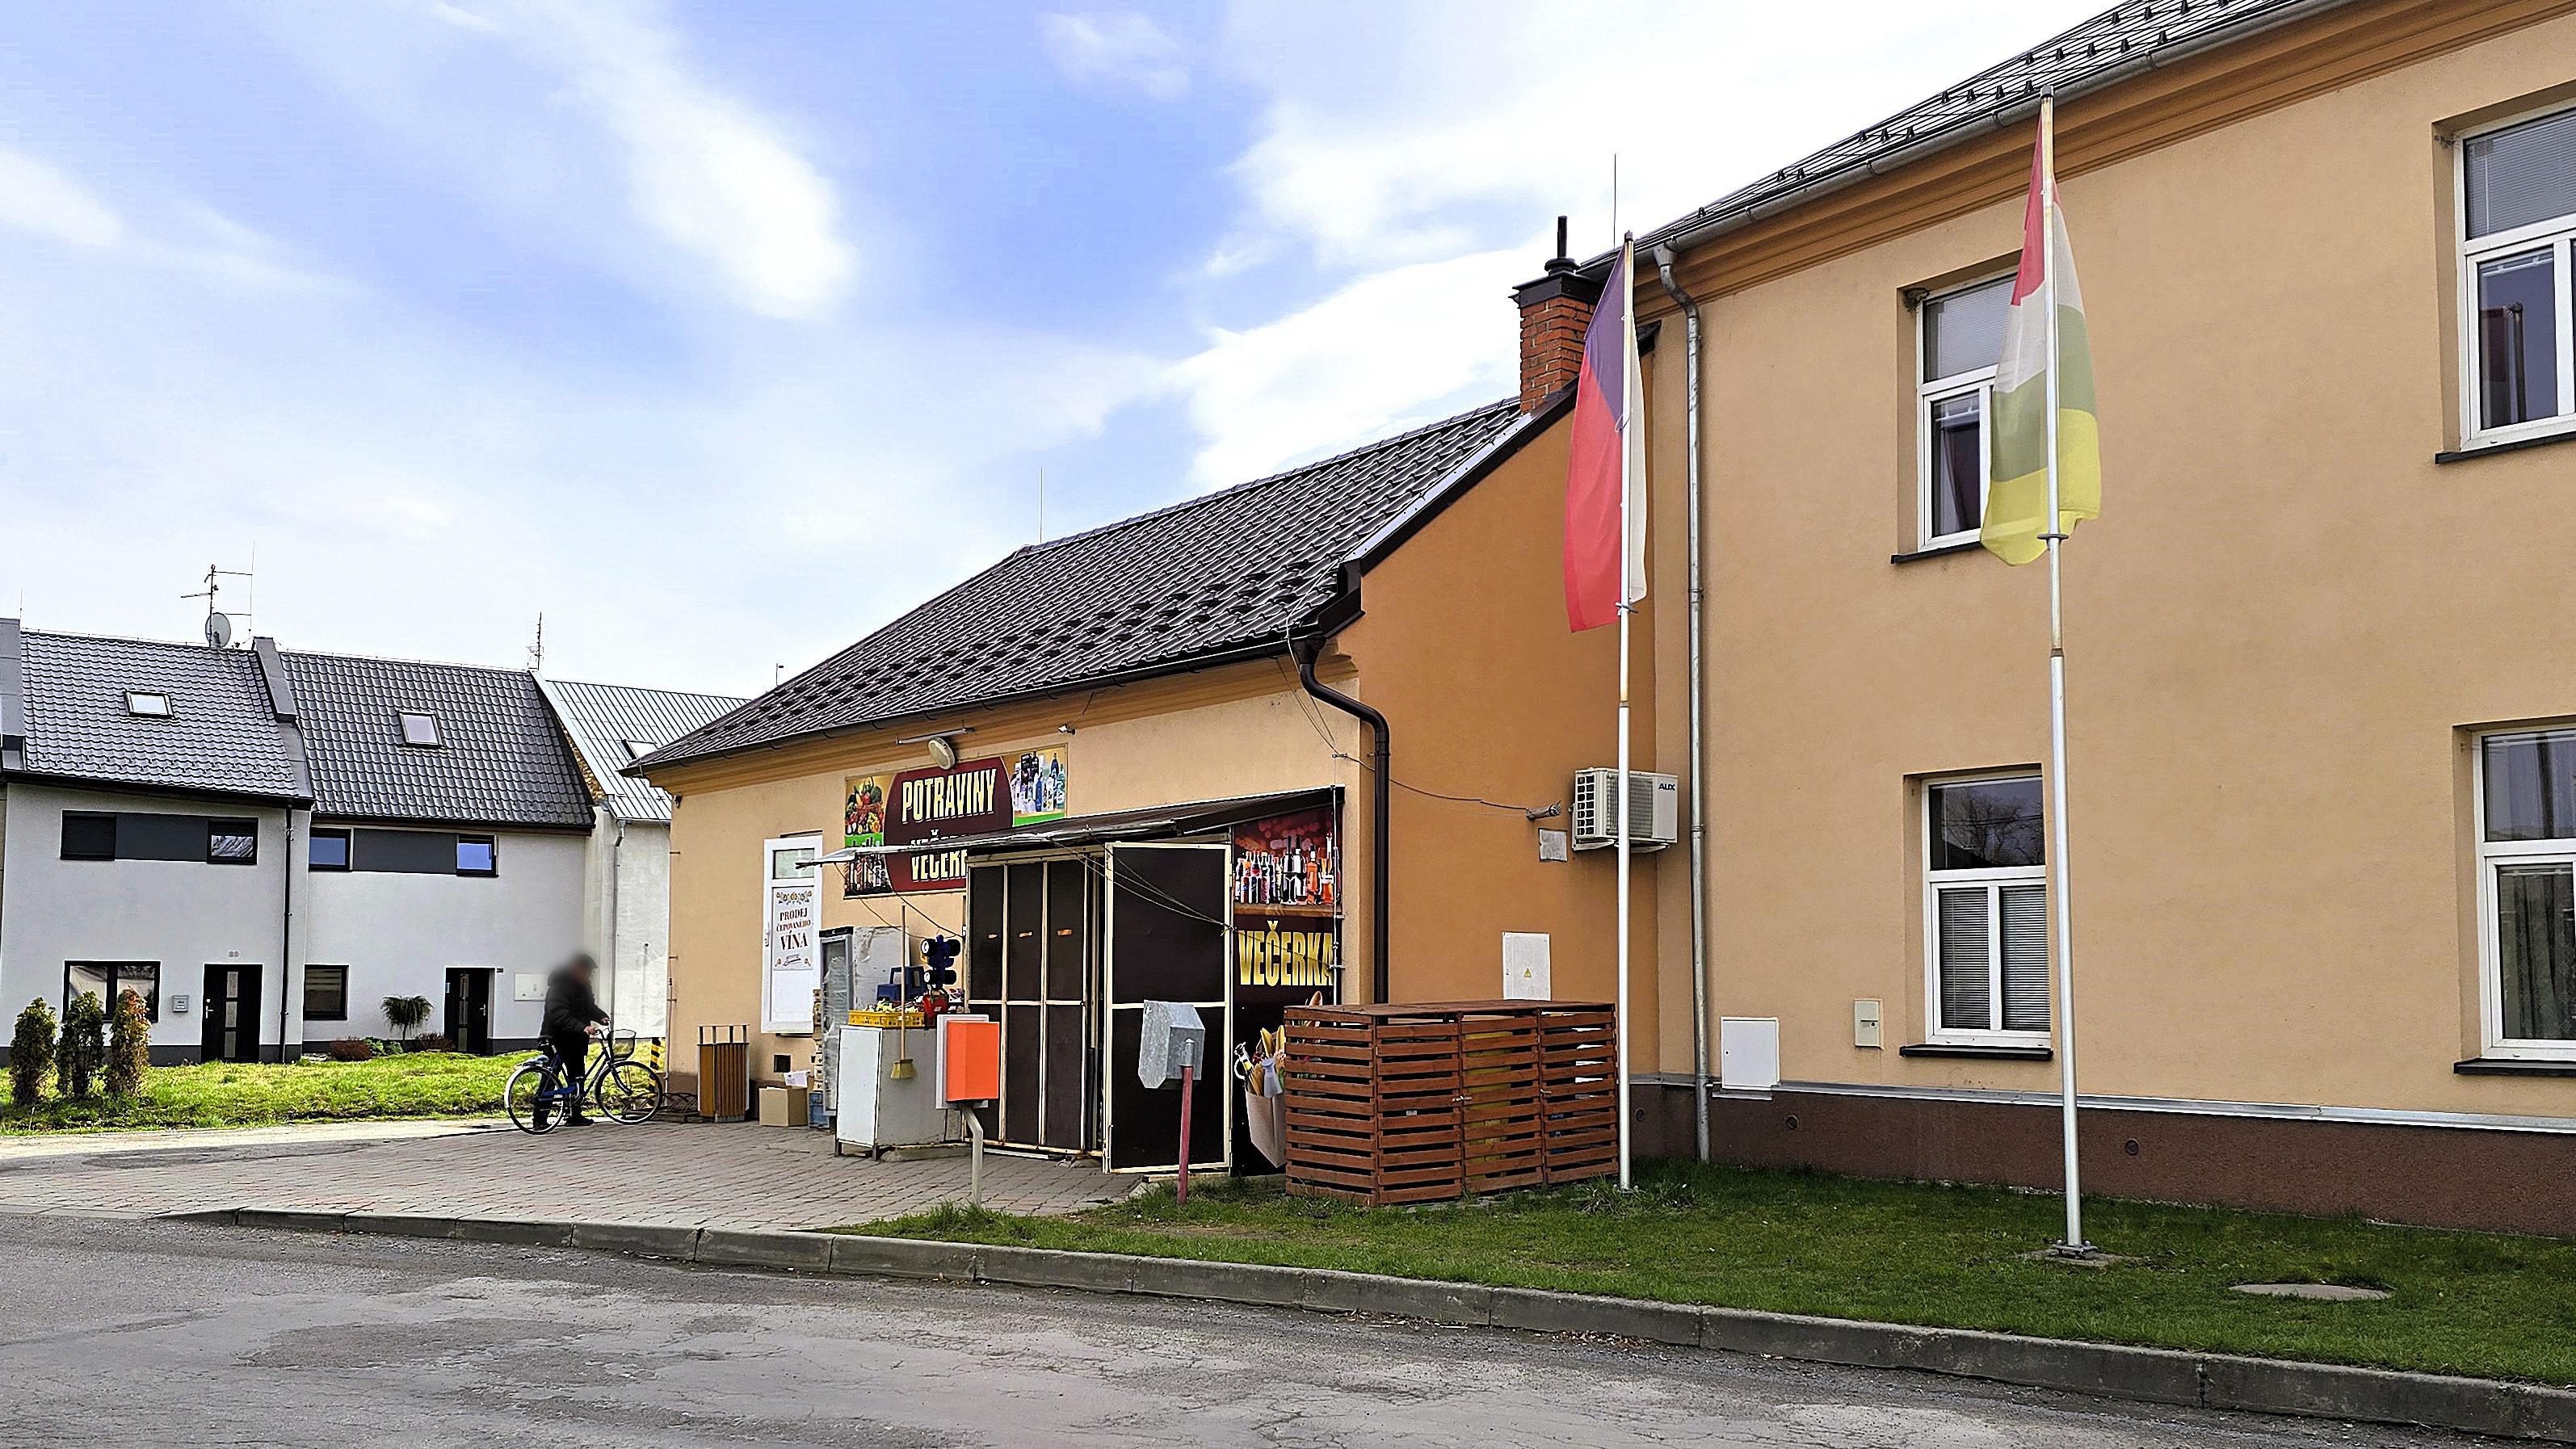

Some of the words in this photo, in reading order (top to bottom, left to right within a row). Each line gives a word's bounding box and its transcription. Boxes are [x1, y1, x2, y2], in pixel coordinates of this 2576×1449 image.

[901, 768, 997, 824] POTRAVINY
[1658, 783, 1675, 791] AUX
[780, 907, 808, 922] PRODEJ
[780, 930, 809, 951] VÍNA
[1238, 920, 1334, 987] VEČERKA
